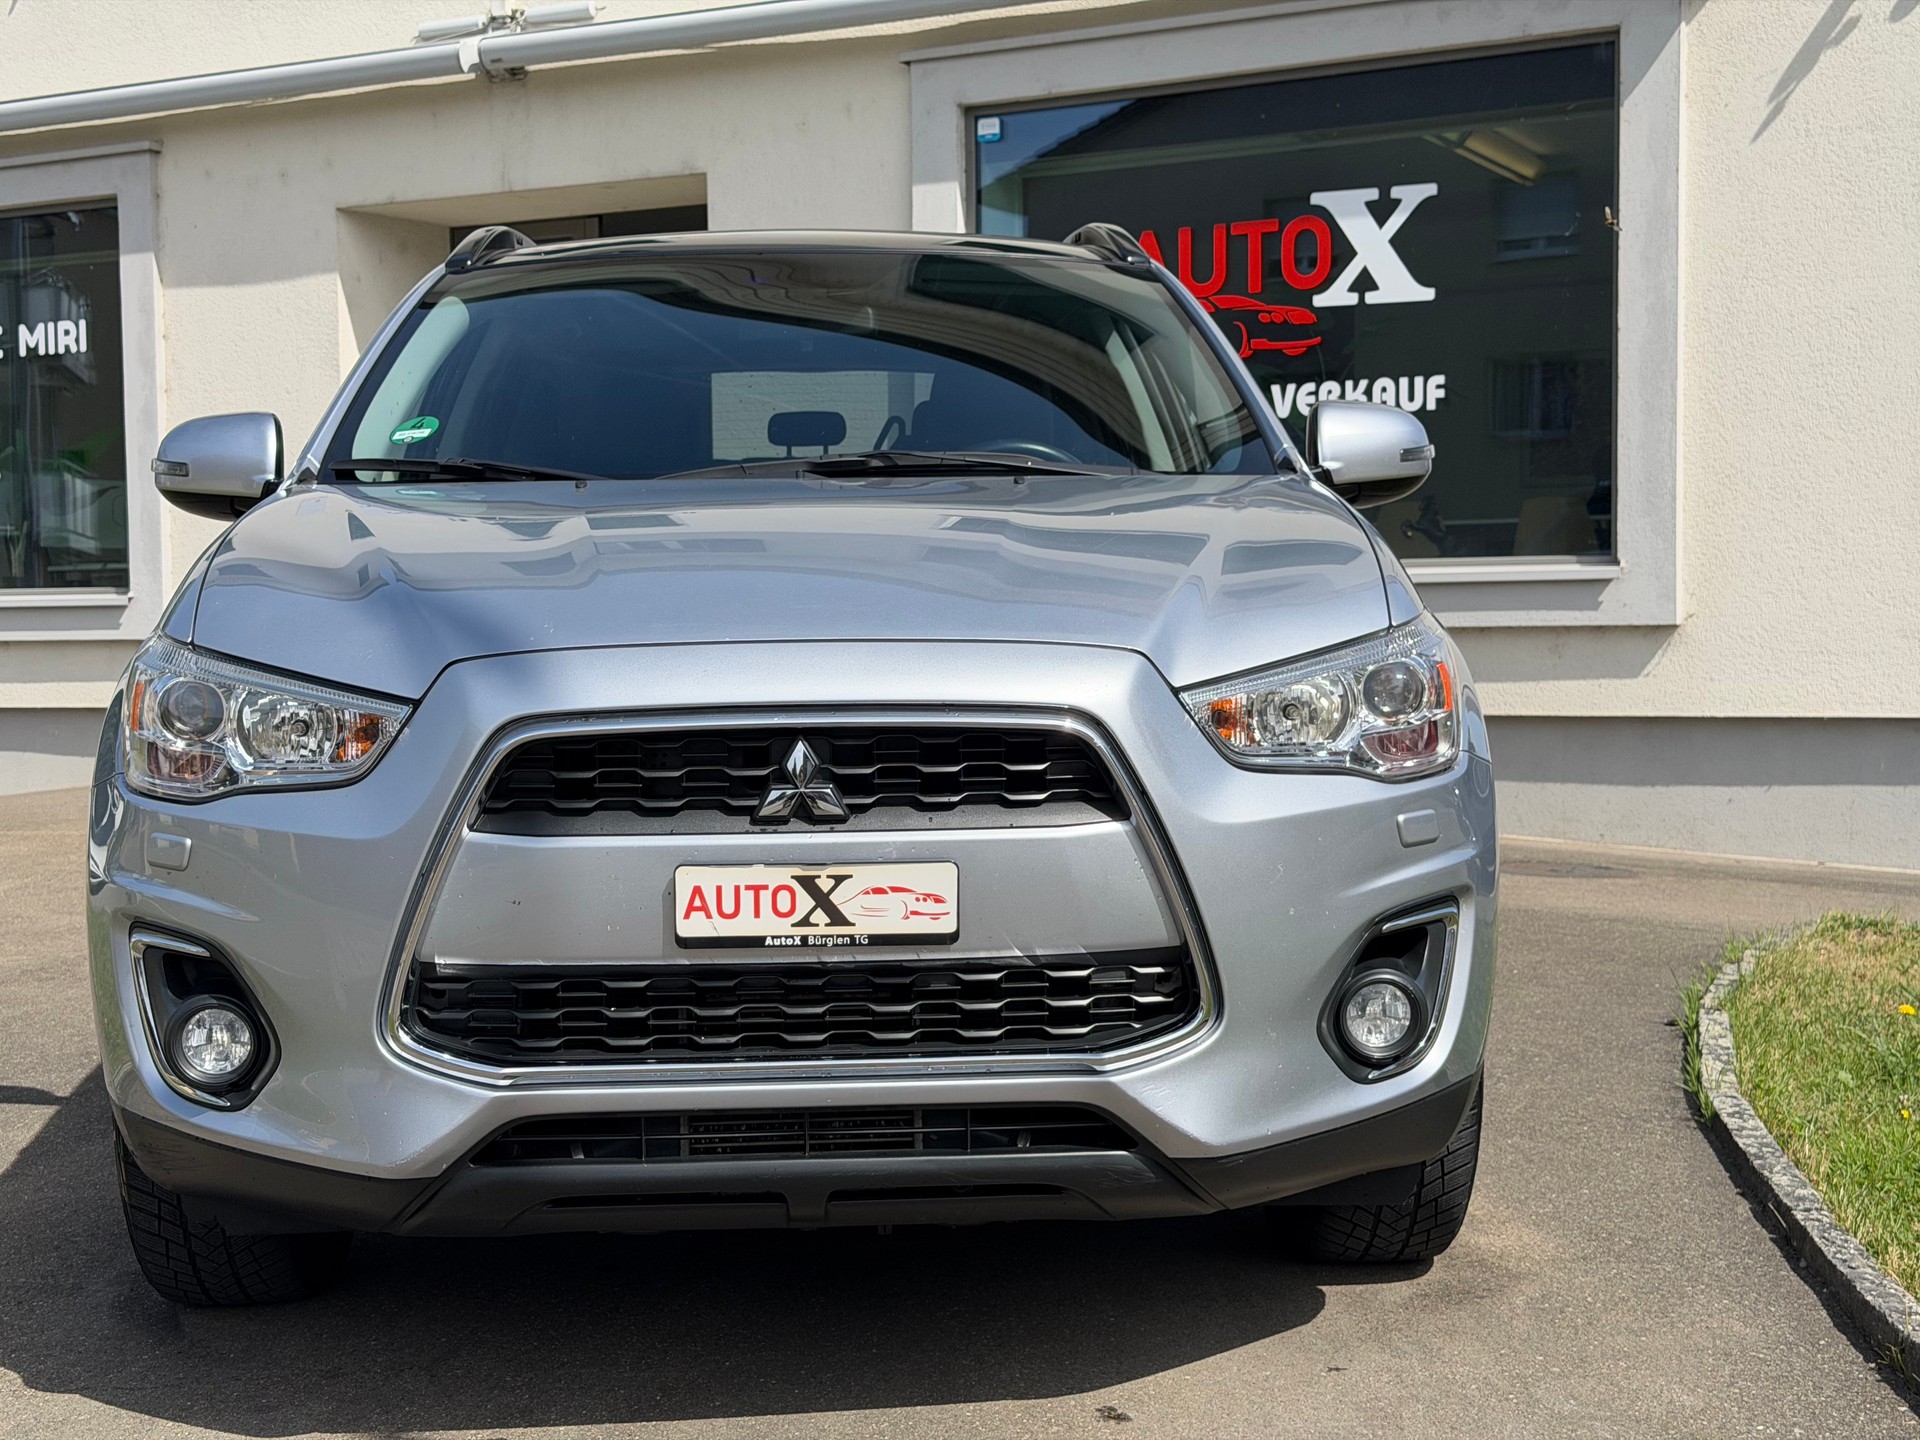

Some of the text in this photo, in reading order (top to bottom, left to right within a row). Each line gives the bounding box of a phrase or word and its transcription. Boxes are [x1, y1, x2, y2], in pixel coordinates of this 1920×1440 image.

[18, 318, 88, 358] MIRI
[1270, 374, 1447, 419] VERKAUF
[764, 934, 869, 947] AutoX Bürglen TG
